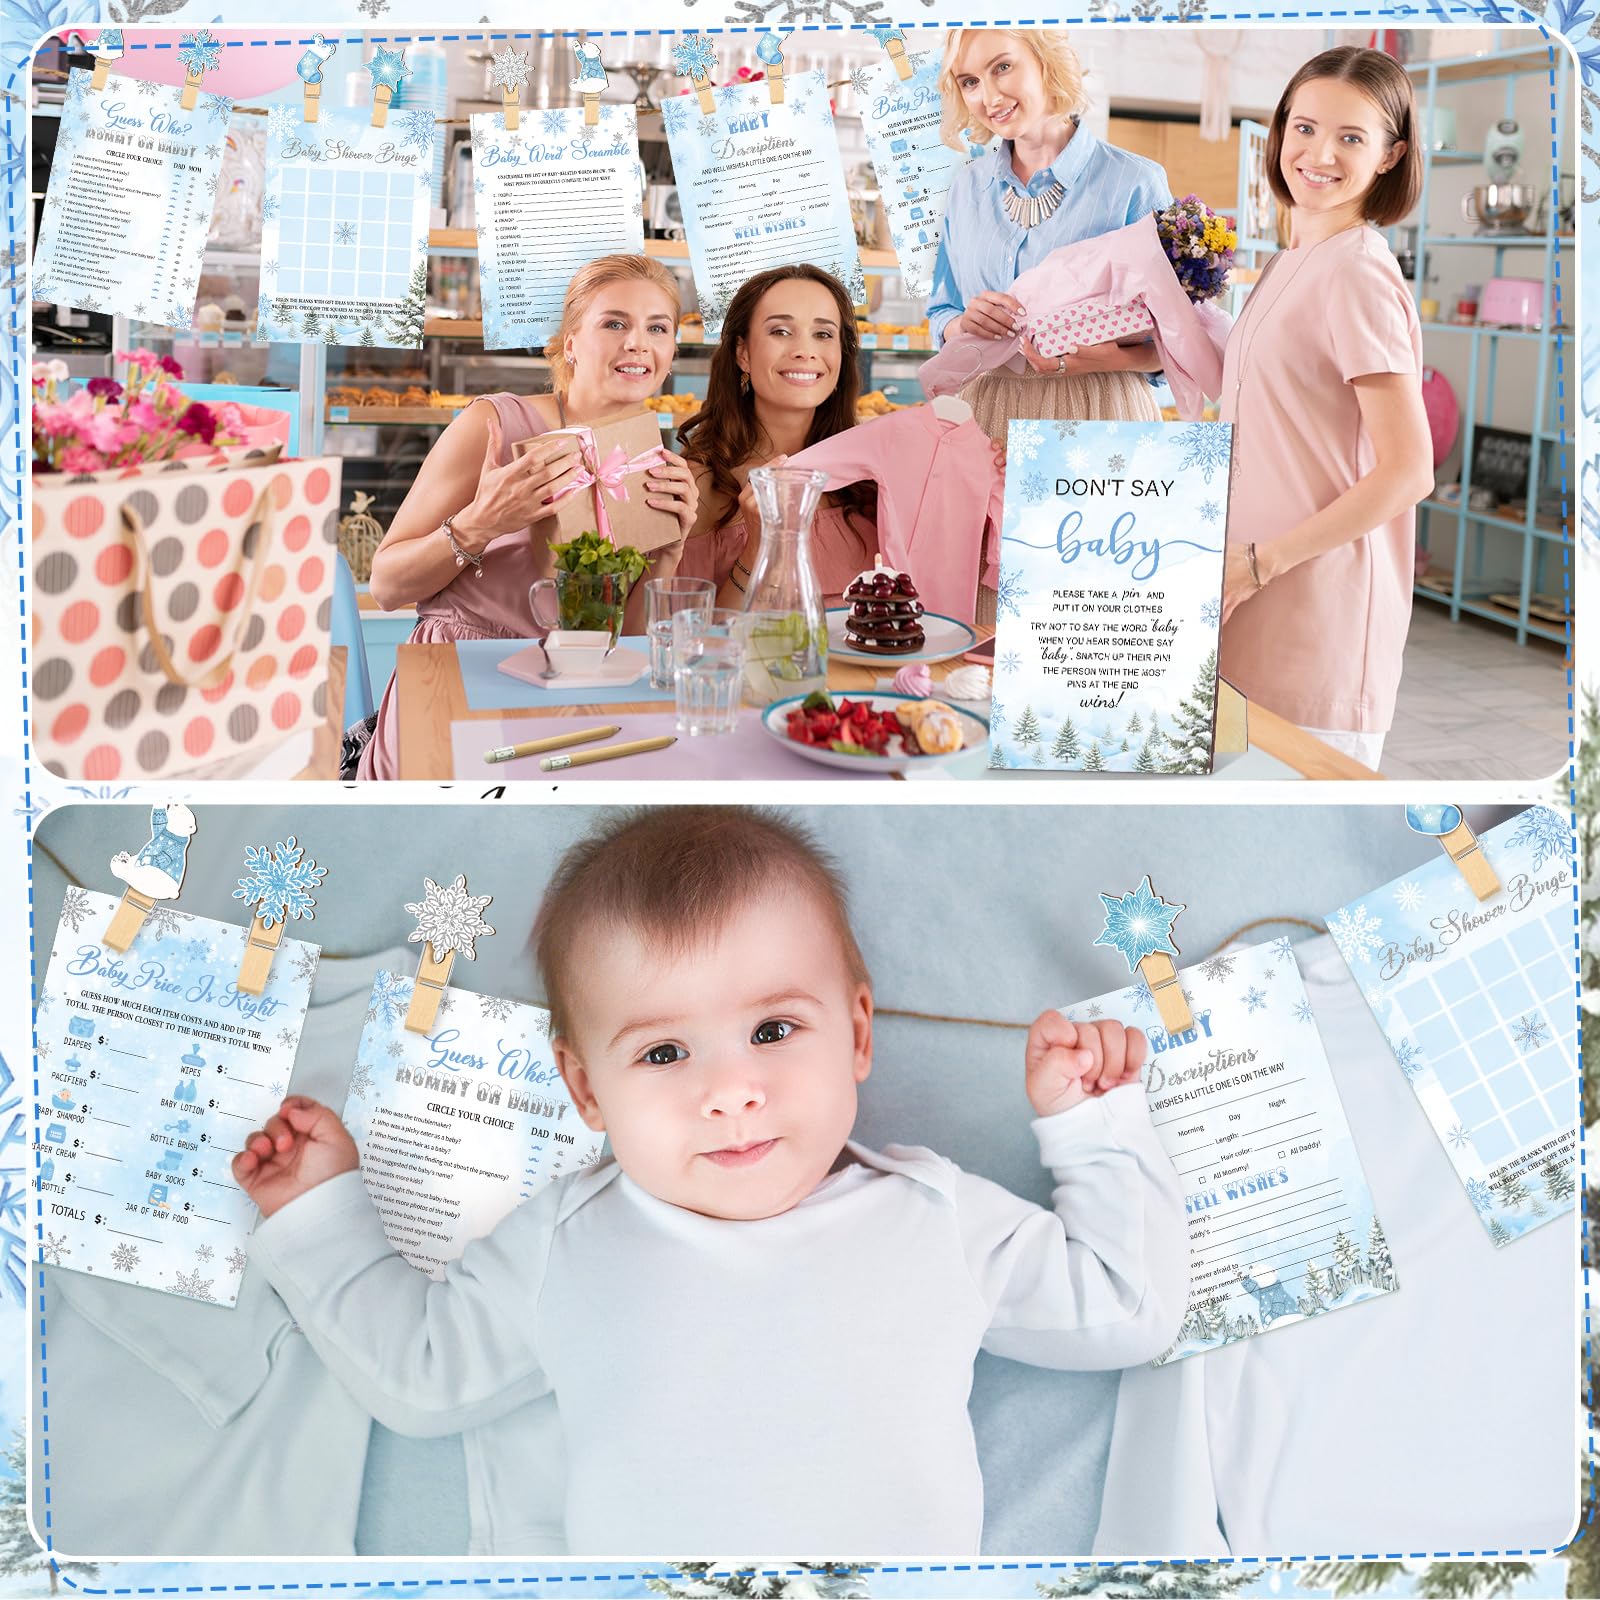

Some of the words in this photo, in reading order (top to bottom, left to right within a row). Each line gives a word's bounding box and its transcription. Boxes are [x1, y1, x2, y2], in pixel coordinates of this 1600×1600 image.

[100, 99, 145, 130] Guess
[149, 107, 193, 136] Who?
[872, 96, 918, 120] Baby
[726, 111, 769, 135] BABY
[85, 124, 135, 146] MOMMY
[137, 134, 155, 151] OR
[157, 140, 199, 159] DADDY
[711, 136, 796, 161] Descriptions
[105, 149, 126, 159] CIRCLE
[126, 153, 142, 162] YOUR
[142, 156, 163, 166] CHOICE
[281, 137, 326, 161] Baby
[324, 138, 374, 160] Shower
[375, 142, 419, 167] Bingo
[480, 143, 526, 168] Baby
[526, 141, 567, 163] Word
[570, 136, 632, 161] Scramble
[173, 162, 186, 170] DAD
[187, 165, 202, 173] MOM
[701, 167, 712, 175] AND
[712, 165, 726, 174] WELL
[725, 161, 746, 170] WISHES
[749, 157, 766, 167] LITTLE
[765, 155, 777, 163] ONE
[790, 150, 801, 158] THE
[800, 149, 812, 157] WAY
[734, 224, 761, 240] WELL
[763, 216, 806, 234] WISHES
[1055, 478, 1125, 496] DON'T
[1130, 479, 1175, 497] SAY
[1052, 589, 1085, 599] PLEASE
[1087, 589, 1109, 599] TAKE
[1111, 590, 1118, 599] A
[1121, 587, 1140, 601] pin
[1146, 591, 1165, 600] AND
[1052, 603, 1070, 612] PUT
[1071, 603, 1080, 612] IT
[1081, 603, 1095, 612] ON
[1096, 603, 1121, 613] YOUR
[1123, 604, 1163, 614] CLOTHES
[1030, 621, 1047, 630] TRY
[1048, 622, 1068, 631] NOT
[1069, 622, 1082, 632] TO
[1082, 622, 1100, 631] SAY
[1102, 623, 1119, 632] THE
[1120, 623, 1148, 632] WORD
[1038, 636, 1064, 645] WHEN
[1065, 636, 1085, 645] YOU
[1085, 636, 1110, 646] HEAR
[1111, 637, 1154, 647] SOMEONE
[1156, 638, 1174, 647] SAY
[1075, 651, 1110, 661] SNATCH
[1111, 652, 1124, 661] UP
[1126, 652, 1151, 661] THEIR
[1153, 653, 1171, 662] PIN!
[1042, 666, 1059, 675] THE
[1060, 666, 1097, 676] PERSON
[1098, 667, 1121, 676] WITH
[1122, 668, 1140, 677] THE
[1141, 668, 1166, 677] MOST
[1066, 680, 1087, 689] PINS
[1088, 680, 1100, 688] AT
[1102, 680, 1119, 689] THE
[1120, 681, 1139, 690] END
[1079, 690, 1125, 709] wins!
[1378, 936, 1447, 981] Baby
[1429, 909, 1507, 946] Shower
[1507, 870, 1572, 913] Bingo
[66, 945, 137, 991] Baby
[133, 961, 182, 995] Price
[185, 975, 217, 1003] Is
[218, 981, 288, 1022] Right
[80, 989, 102, 1001] GUESS
[102, 994, 121, 1005] HOW
[120, 999, 142, 1011] MUCH
[142, 1004, 162, 1016] EACH
[162, 1008, 180, 1020] ITEM
[180, 1013, 203, 1025] COSTS
[203, 1019, 219, 1029] AND
[219, 1023, 236, 1033] ADD
[236, 1026, 246, 1036] UP
[247, 1029, 262, 1040] THE
[65, 998, 90, 1011] TOTAL.
[91, 1004, 106, 1015] THE
[106, 1008, 134, 1021] PERSON
[134, 1015, 165, 1028] CLOSEST
[165, 1022, 176, 1031] TO
[176, 1024, 191, 1035] THE
[191, 1028, 227, 1044] MOTHER'S
[227, 1037, 250, 1050] TOTAL
[252, 1042, 272, 1054] WINS!
[1145, 1009, 1213, 1054] BABY
[63, 1036, 92, 1051] DIAPERS
[423, 1029, 488, 1072] Guess
[497, 1039, 561, 1087] Who?
[50, 1071, 88, 1087] PACIFIERS
[180, 1065, 201, 1078] WIPES
[1143, 1049, 1259, 1094] Descriptions
[395, 1063, 474, 1097] MOMMY
[476, 1081, 503, 1106] OR
[508, 1090, 571, 1120] DADDY
[1153, 1094, 1184, 1111] WISHES
[1184, 1092, 1190, 1101] A
[1189, 1084, 1215, 1100] LITTLE
[1215, 1078, 1232, 1091] ONE
[1231, 1076, 1241, 1086] IS
[1240, 1072, 1253, 1083] ON
[1252, 1066, 1269, 1079] THE
[1268, 1061, 1285, 1074] WAY
[160, 1098, 178, 1108] BABY
[180, 1102, 205, 1116] LOTION
[1268, 1098, 1286, 1109] Night
[56, 1110, 85, 1124] SHAMPOO
[426, 1102, 457, 1117] CIRCLE
[458, 1109, 481, 1123] YOUR
[482, 1115, 515, 1131] CHOICE
[1228, 1113, 1241, 1122] Day
[530, 1126, 550, 1139] DAD
[553, 1132, 575, 1145] MOM
[1177, 1125, 1205, 1137] Morning
[1214, 1132, 1239, 1145] Length:
[149, 1132, 175, 1147] BOTTLE
[177, 1139, 199, 1152] BRUSH
[1290, 1146, 1299, 1156] All
[1298, 1140, 1322, 1153] Daddy!
[1507, 1158, 1521, 1169] THE
[1519, 1147, 1543, 1163] BLANKS
[1541, 1139, 1558, 1151] WITH
[1557, 1131, 1571, 1143] GIFT
[55, 1147, 77, 1159] CREAM
[1220, 1152, 1234, 1162] Hair
[1234, 1147, 1253, 1157] color:
[145, 1169, 162, 1180] BABY
[164, 1174, 186, 1187] SOCKS
[1213, 1171, 1222, 1180] All
[1221, 1162, 1250, 1177] Mommy!
[1222, 1167, 1289, 1201] WISHES
[50, 1203, 86, 1221] TOTALS
[124, 1202, 138, 1212] JAR
[140, 1206, 150, 1215] OF
[152, 1208, 170, 1219] BABY
[171, 1213, 189, 1225] FOOD
